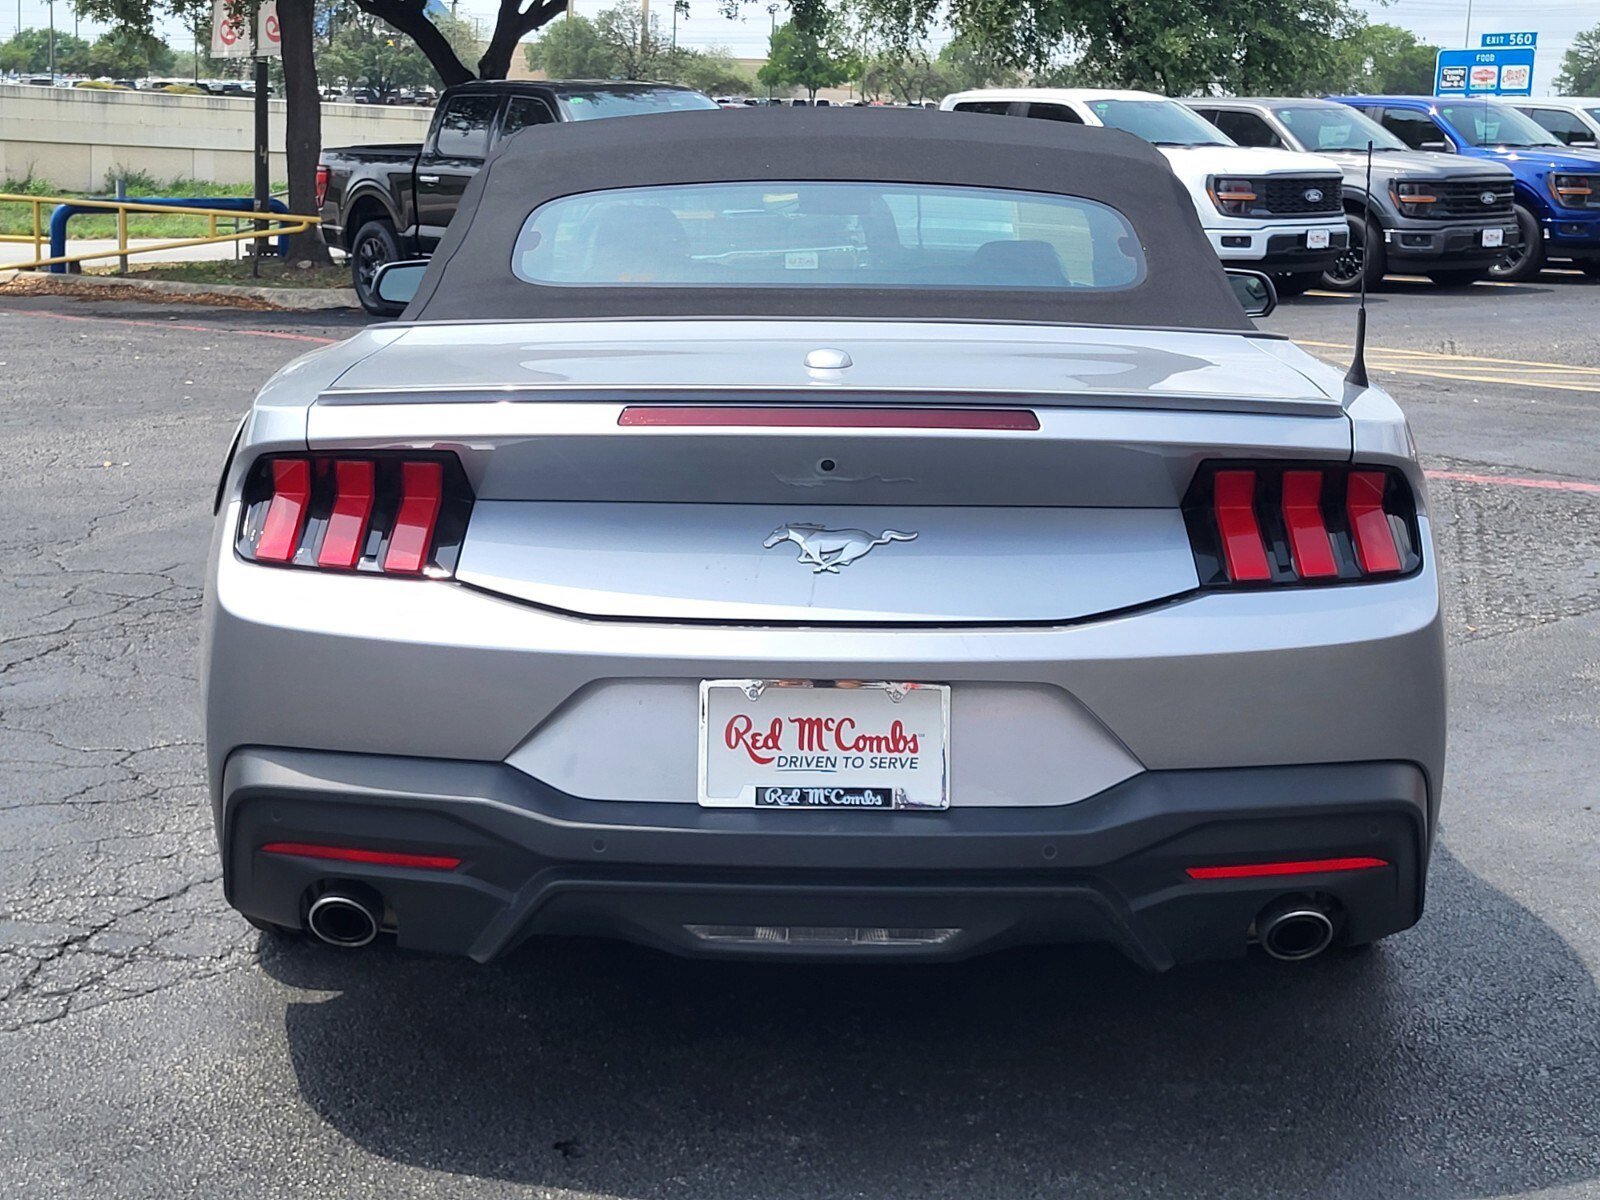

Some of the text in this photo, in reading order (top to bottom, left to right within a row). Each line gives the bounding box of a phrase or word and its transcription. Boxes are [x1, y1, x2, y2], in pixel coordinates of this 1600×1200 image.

[1486, 33, 1532, 45] EXIT 560
[1476, 54, 1495, 62] FOOD
[725, 714, 919, 764] Red McCombs
[776, 755, 919, 770] DRIVEN TO SERVE
[765, 786, 882, 806] Red McCombs
